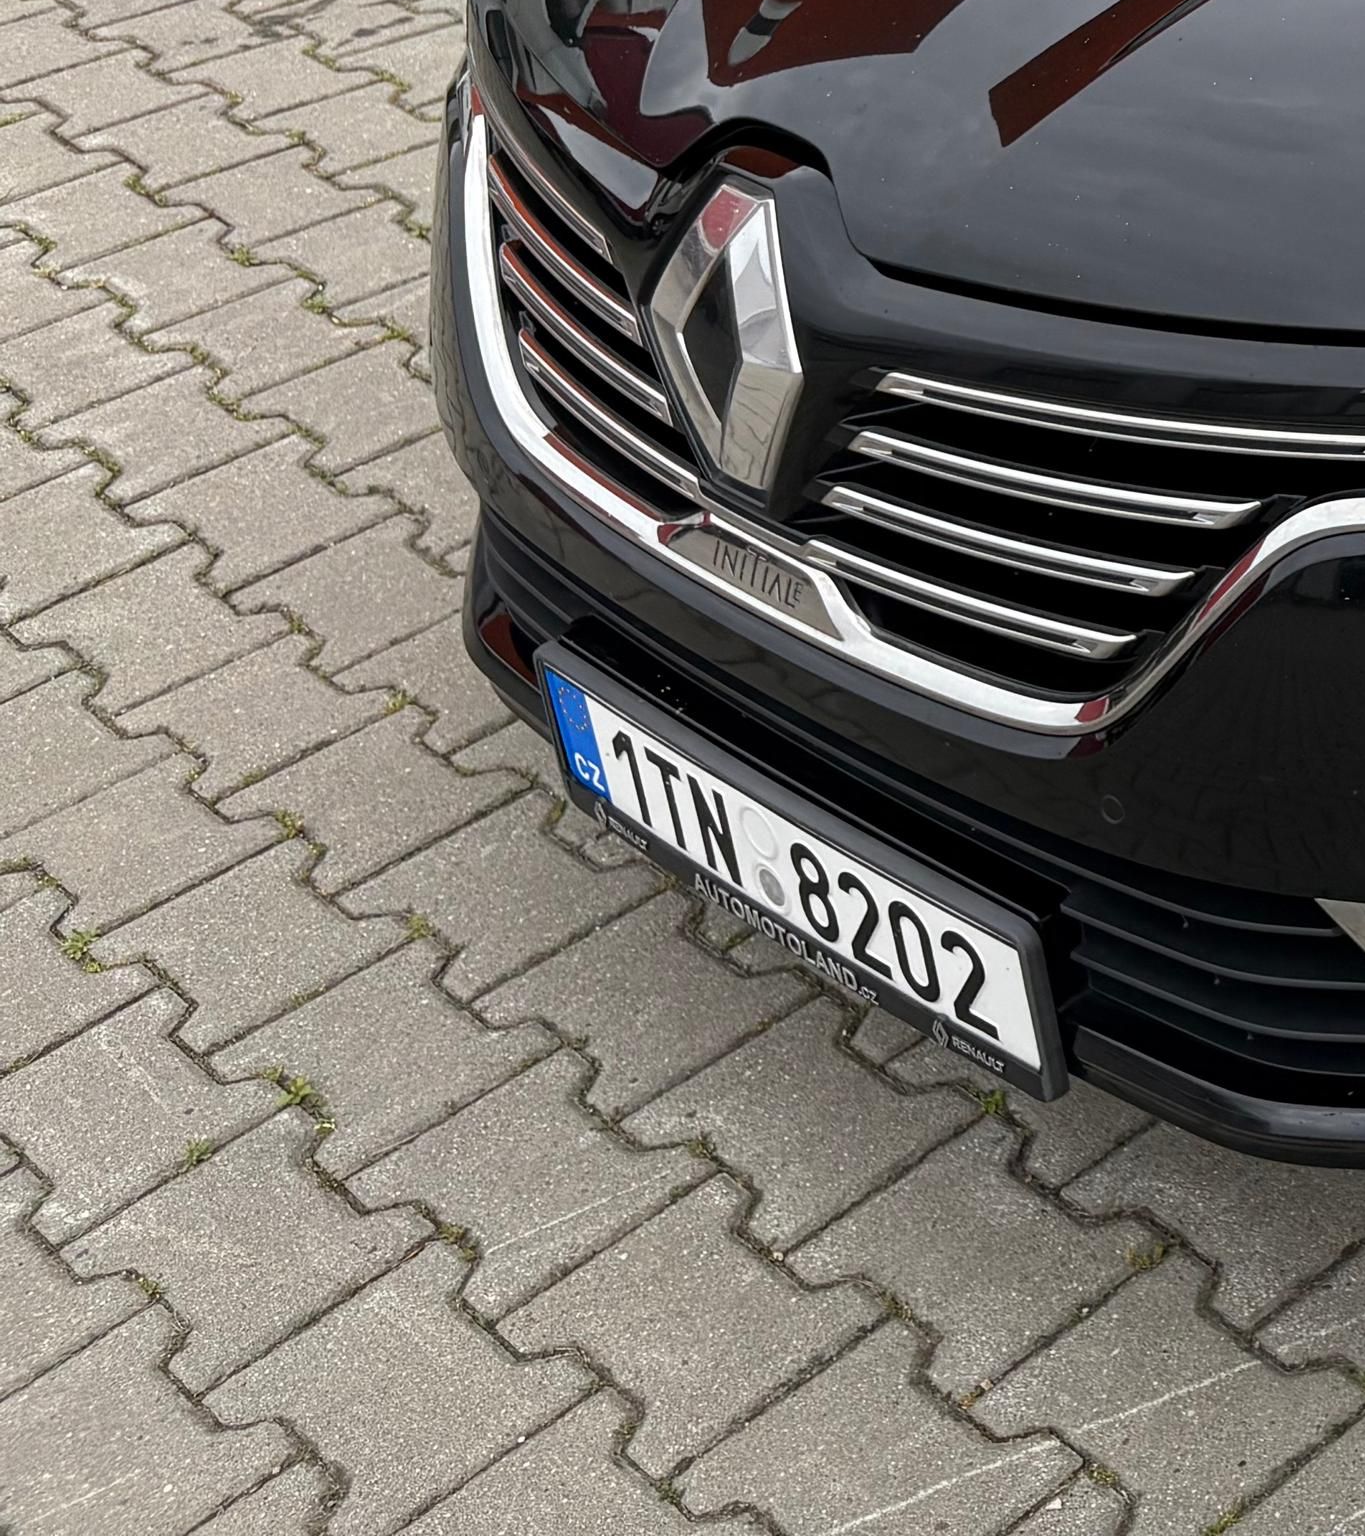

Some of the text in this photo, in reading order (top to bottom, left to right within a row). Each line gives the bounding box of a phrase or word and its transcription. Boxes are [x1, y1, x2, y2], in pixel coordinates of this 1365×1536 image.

[713, 539, 803, 609] INITIALE
[574, 751, 605, 792] CZ
[612, 729, 999, 1041] 1TN 8202
[952, 1034, 1005, 1073] RENAULT
